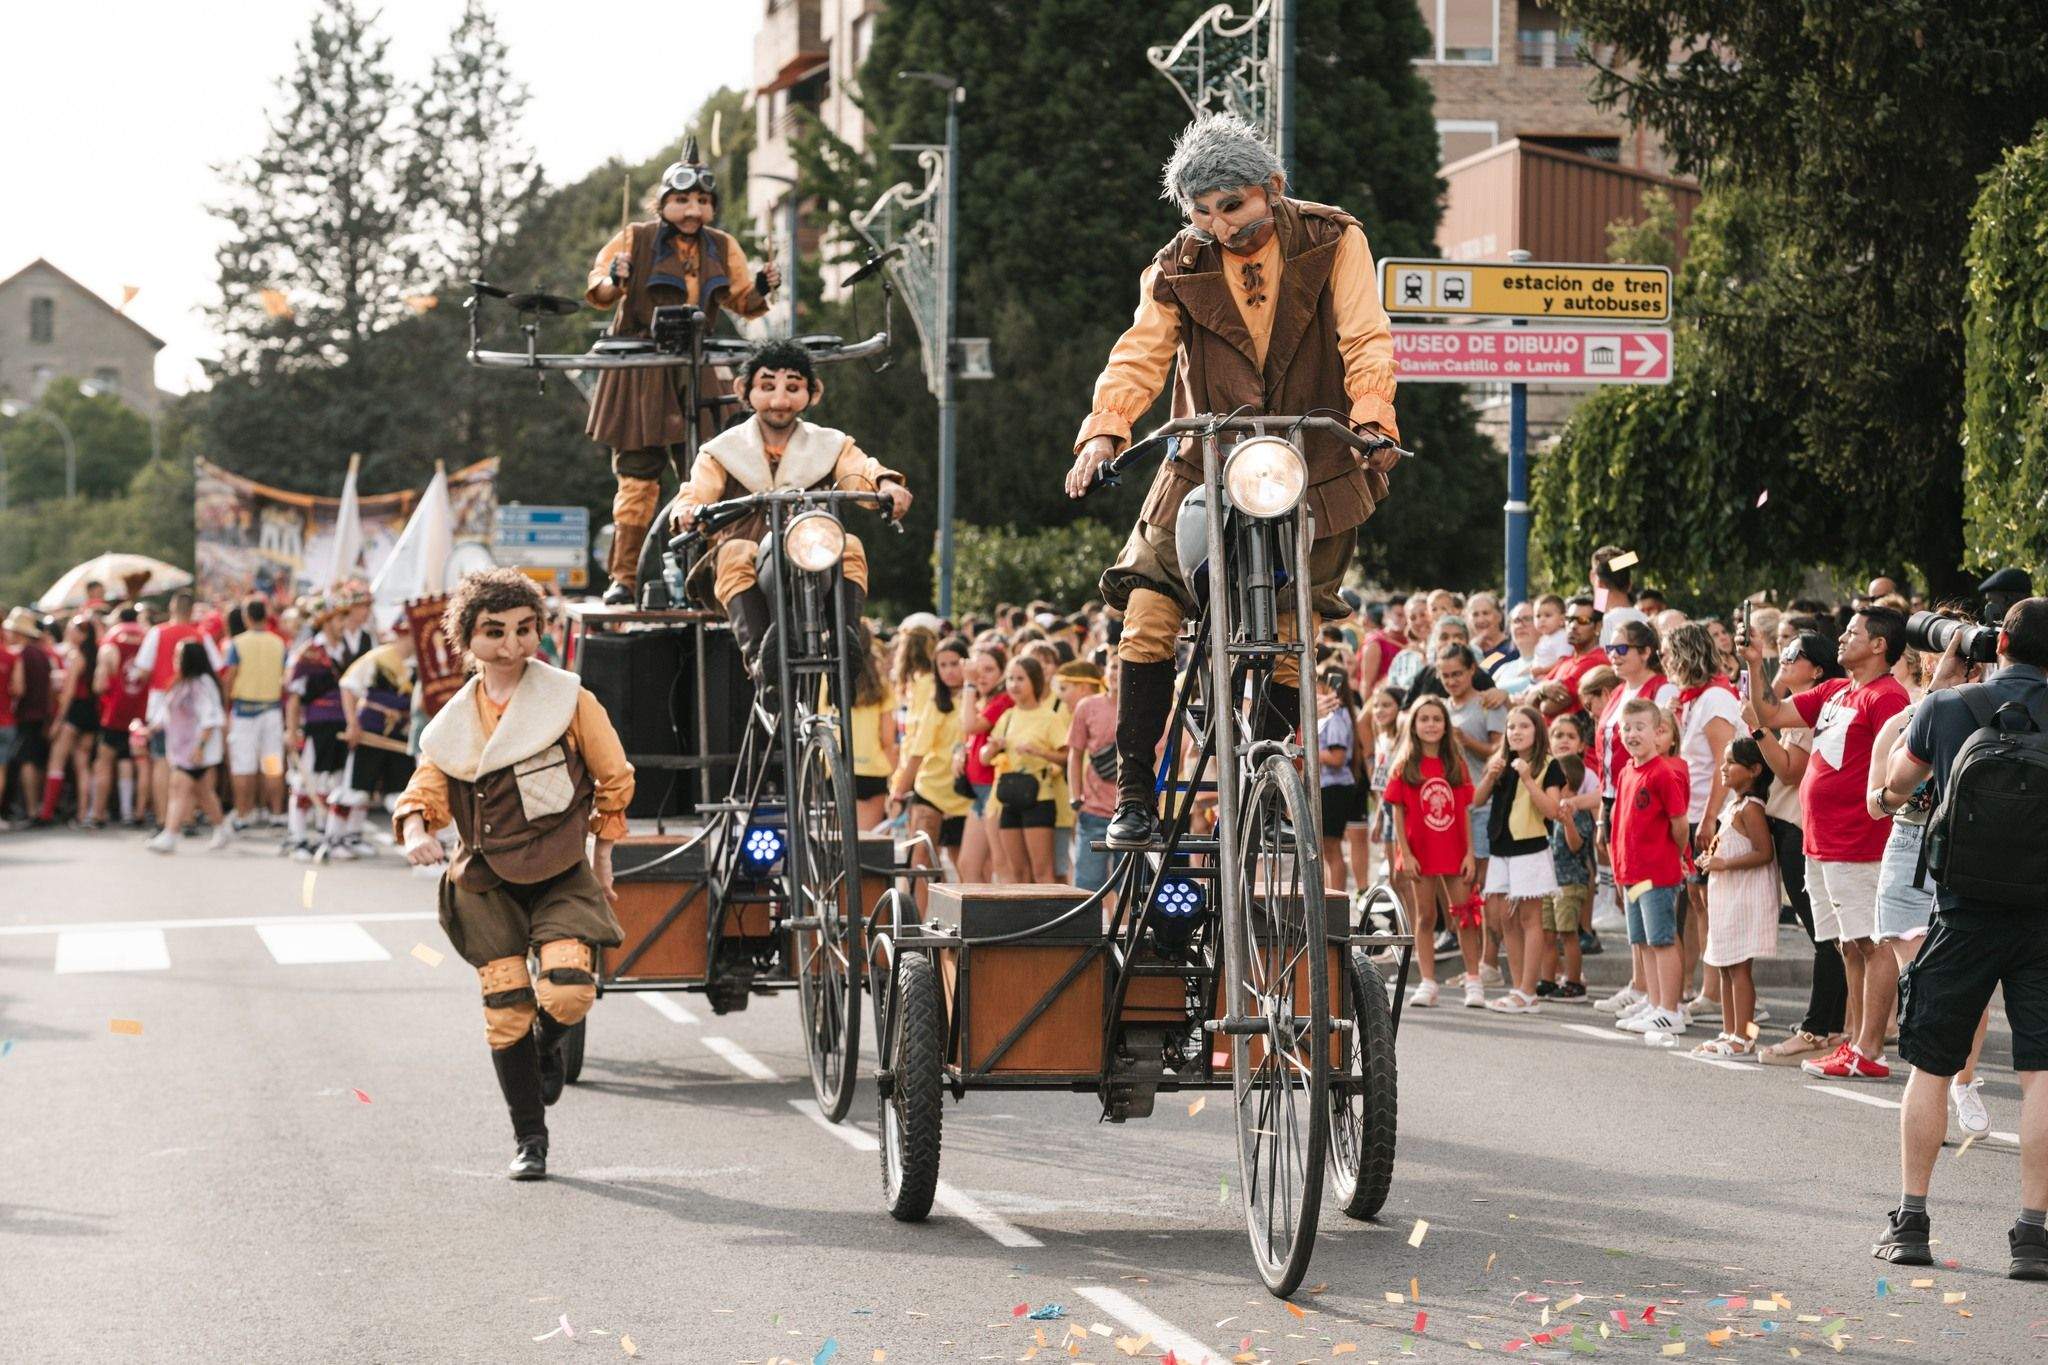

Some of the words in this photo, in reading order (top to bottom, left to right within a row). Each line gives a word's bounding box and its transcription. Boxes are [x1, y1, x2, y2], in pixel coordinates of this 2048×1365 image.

[1503, 274, 1582, 291] estación
[1592, 277, 1615, 292] de
[1625, 277, 1663, 294] tren
[1543, 297, 1554, 312] y
[1564, 295, 1662, 312] autobuses
[1467, 335, 1496, 353] DE
[1503, 335, 1579, 354] DIBUJO
[1503, 359, 1522, 373] de
